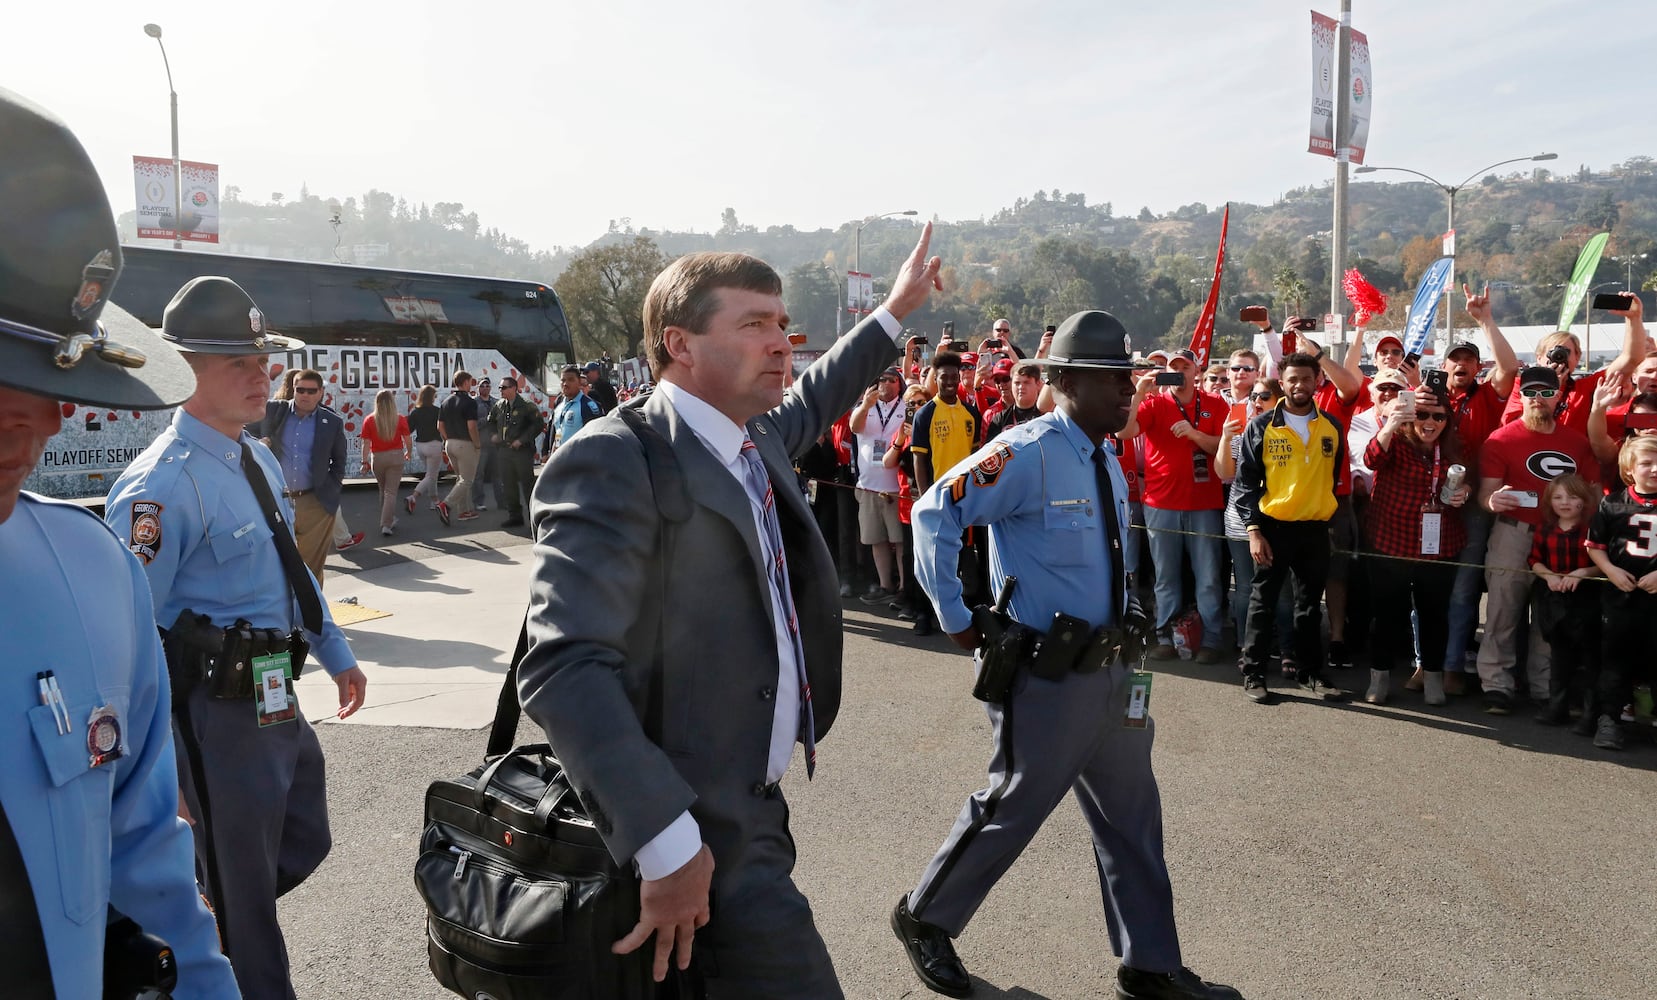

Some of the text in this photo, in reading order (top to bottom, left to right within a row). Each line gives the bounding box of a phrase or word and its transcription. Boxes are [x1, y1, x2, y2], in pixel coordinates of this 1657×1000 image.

[526, 290, 537, 298] 624
[340, 350, 466, 389] GEORGIA
[44, 447, 147, 467] PLAYOFF SEMI
[1268, 445, 1293, 454] 2716
[134, 503, 159, 515] GEORGIA
[1626, 513, 1657, 558] 3
